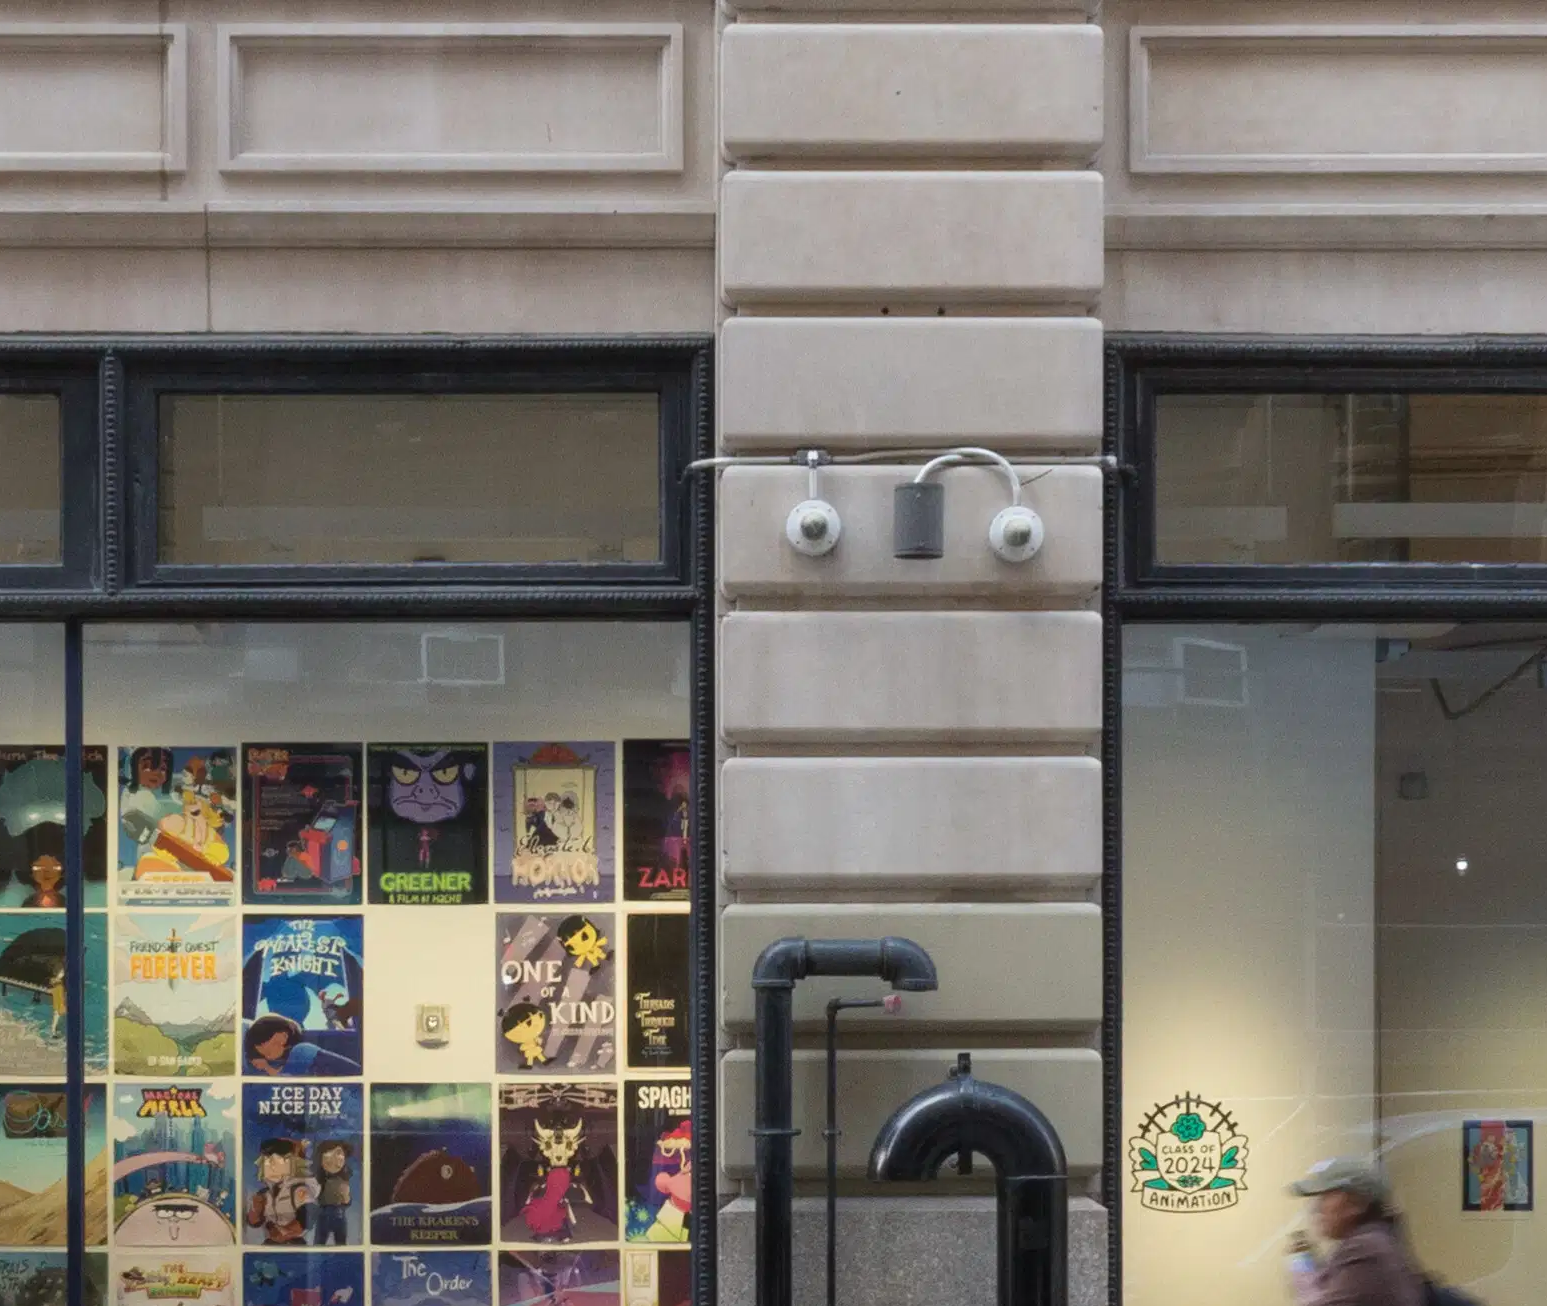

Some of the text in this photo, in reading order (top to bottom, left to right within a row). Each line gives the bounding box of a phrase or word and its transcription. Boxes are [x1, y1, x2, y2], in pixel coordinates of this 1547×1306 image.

[380, 871, 472, 893] GREENER
[396, 893, 419, 904] FILM
[185, 940, 220, 953] QUEST
[129, 953, 217, 980] FOREVER
[270, 955, 340, 977] KNIGHT
[501, 960, 563, 985] ONE
[562, 987, 571, 998] A
[549, 1001, 615, 1025] KIND
[271, 1086, 344, 1100] ICE DAY
[259, 1101, 343, 1115] NICE DAY
[1161, 1145, 1216, 1155] CLASS OF
[1164, 1156, 1216, 1174] 2024
[389, 1214, 480, 1227] THE KRAKEN'S
[410, 1229, 459, 1241] KEEPER
[393, 1254, 427, 1280] The
[425, 1271, 474, 1296] Order
